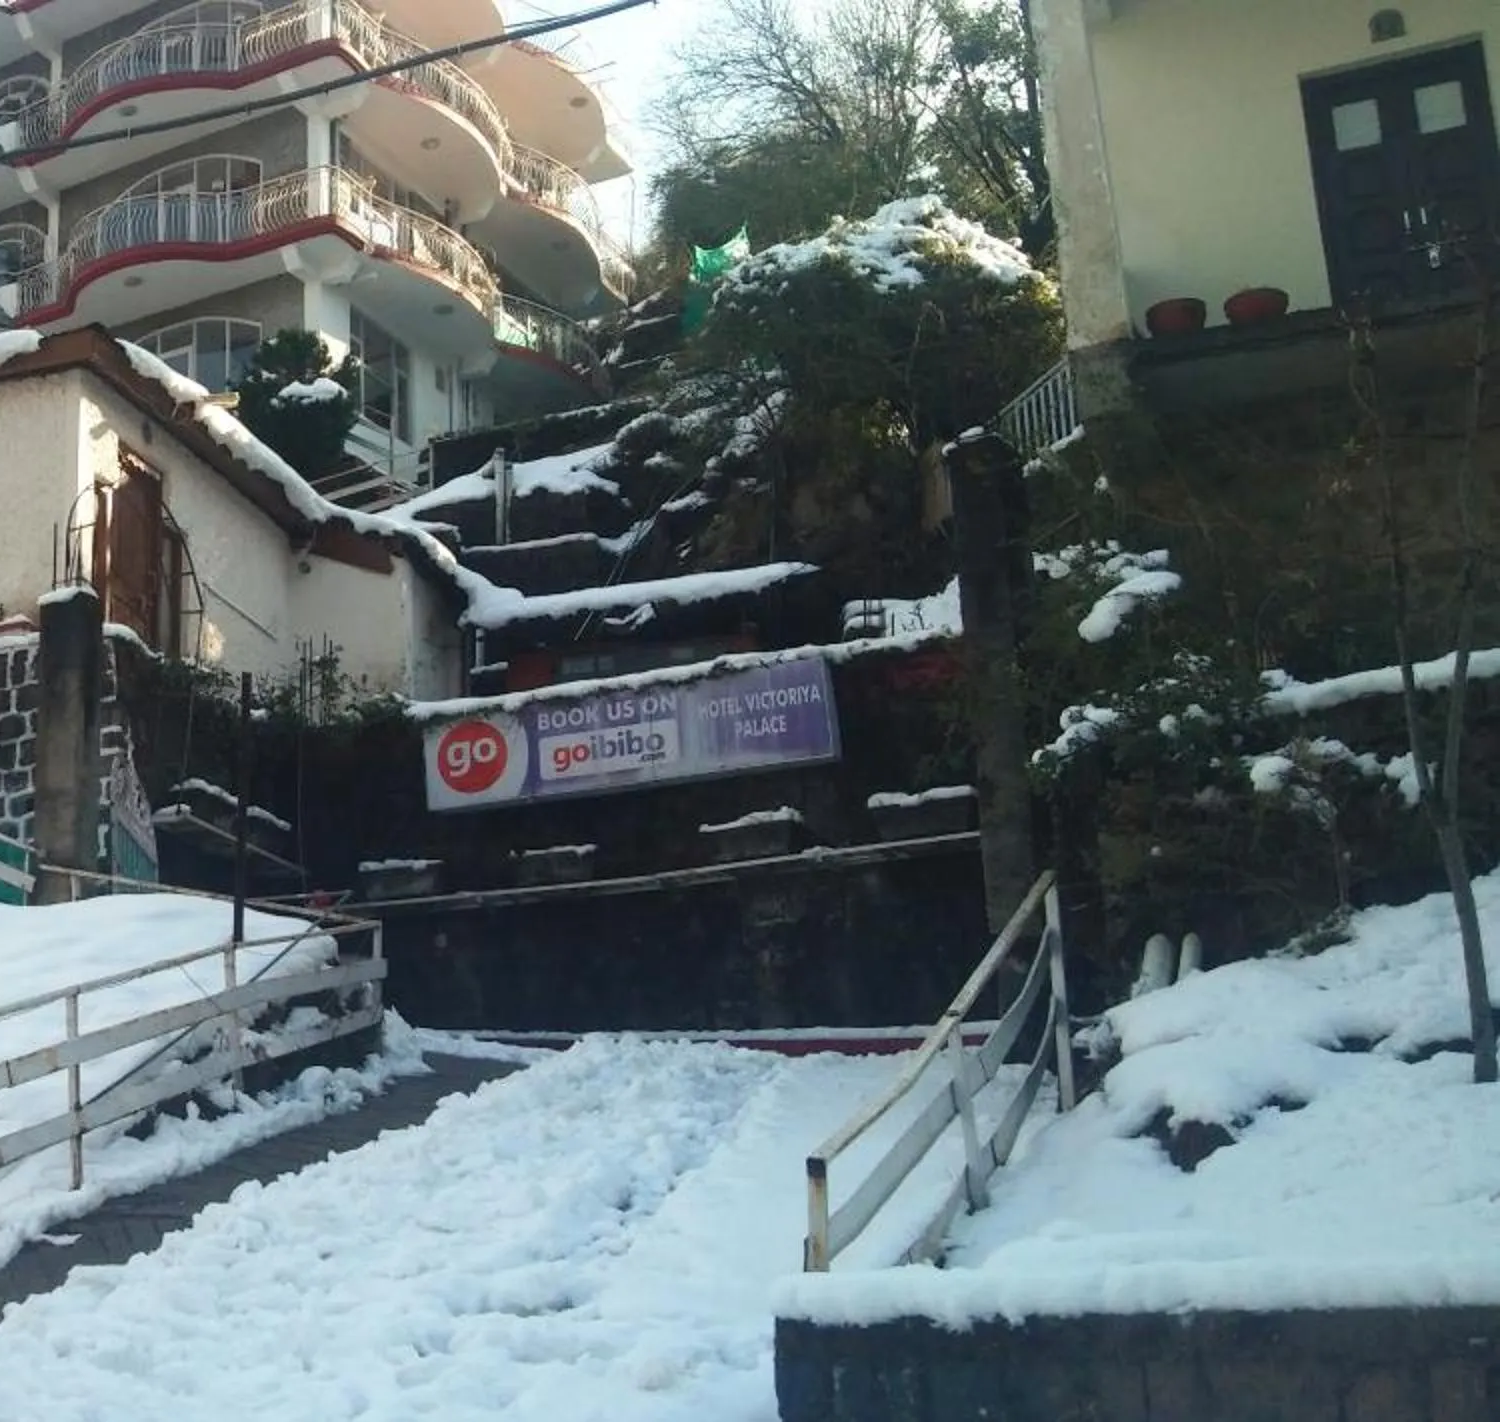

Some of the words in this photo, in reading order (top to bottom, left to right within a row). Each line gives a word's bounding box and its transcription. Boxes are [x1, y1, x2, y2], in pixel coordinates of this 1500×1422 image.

[538, 706, 600, 731] BOOK
[606, 699, 636, 721] US
[642, 692, 677, 714] ON
[700, 696, 743, 720] HOTEL
[744, 684, 821, 713] VICTORIYA
[734, 715, 788, 738] PALACE
[446, 737, 498, 777] go
[553, 729, 666, 773] goibibo
